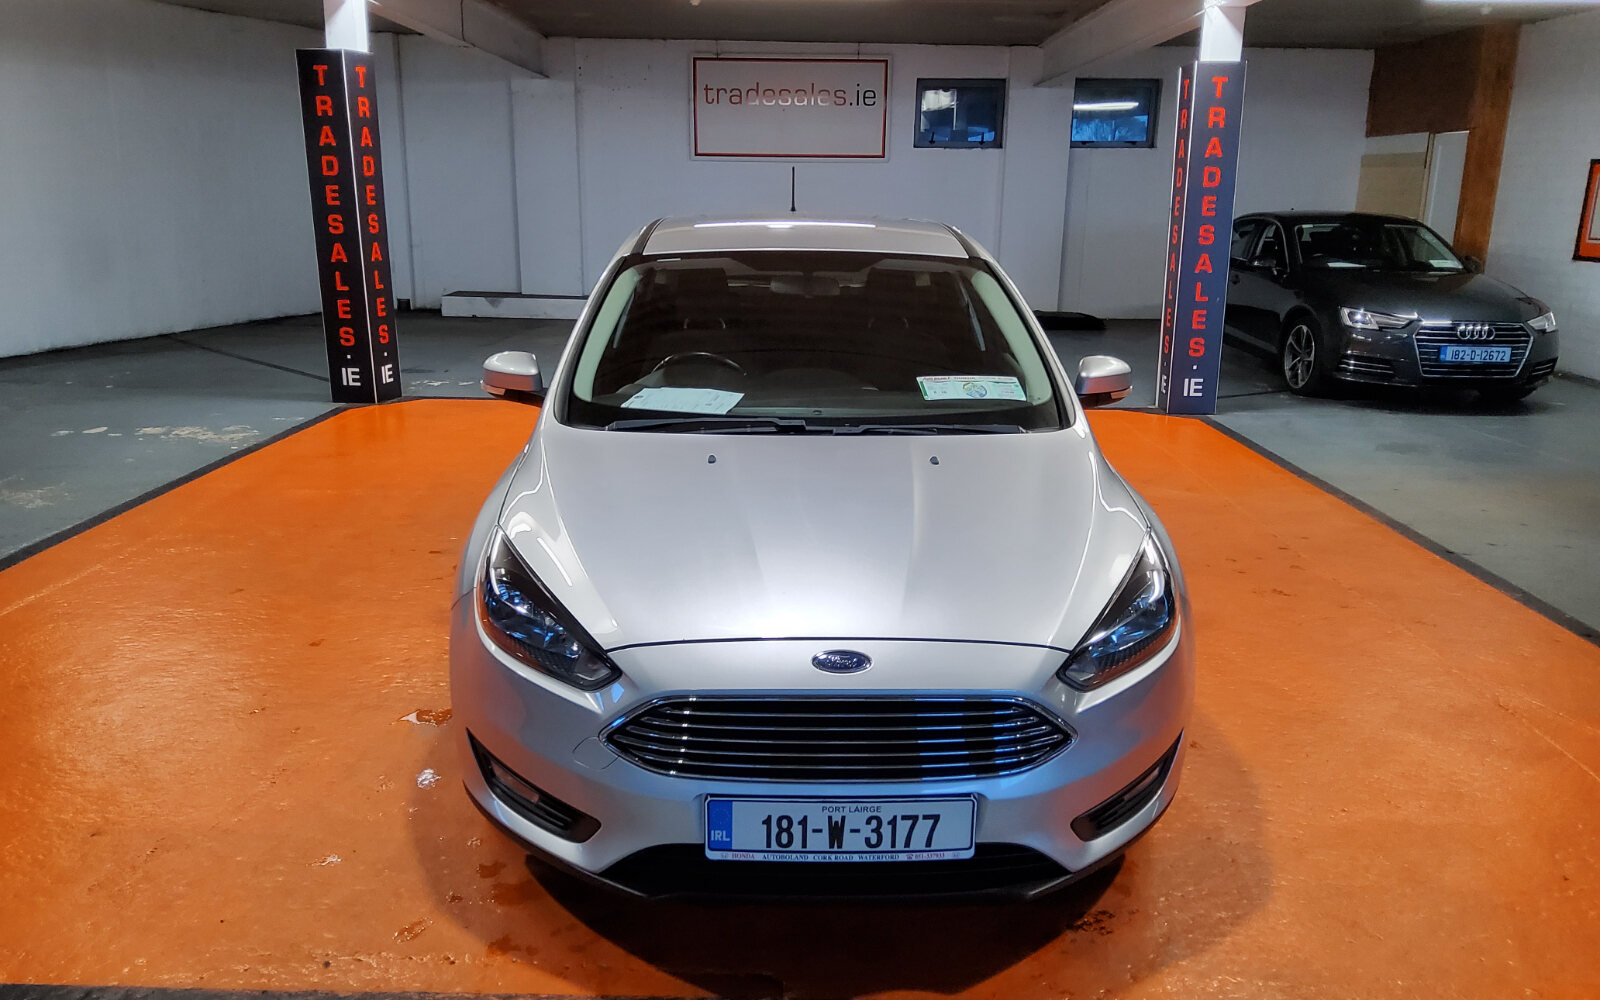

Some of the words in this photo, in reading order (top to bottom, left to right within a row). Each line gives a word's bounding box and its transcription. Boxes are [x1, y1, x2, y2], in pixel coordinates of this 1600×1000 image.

[703, 81, 877, 107] tradesales.ie
[1450, 349, 1507, 361] 182-D-12672
[821, 805, 846, 813] PORT
[848, 804, 882, 813] LÁIRGE
[710, 829, 731, 842] IRL
[761, 813, 941, 850] 181-W-3177
[731, 852, 755, 860] HONDA
